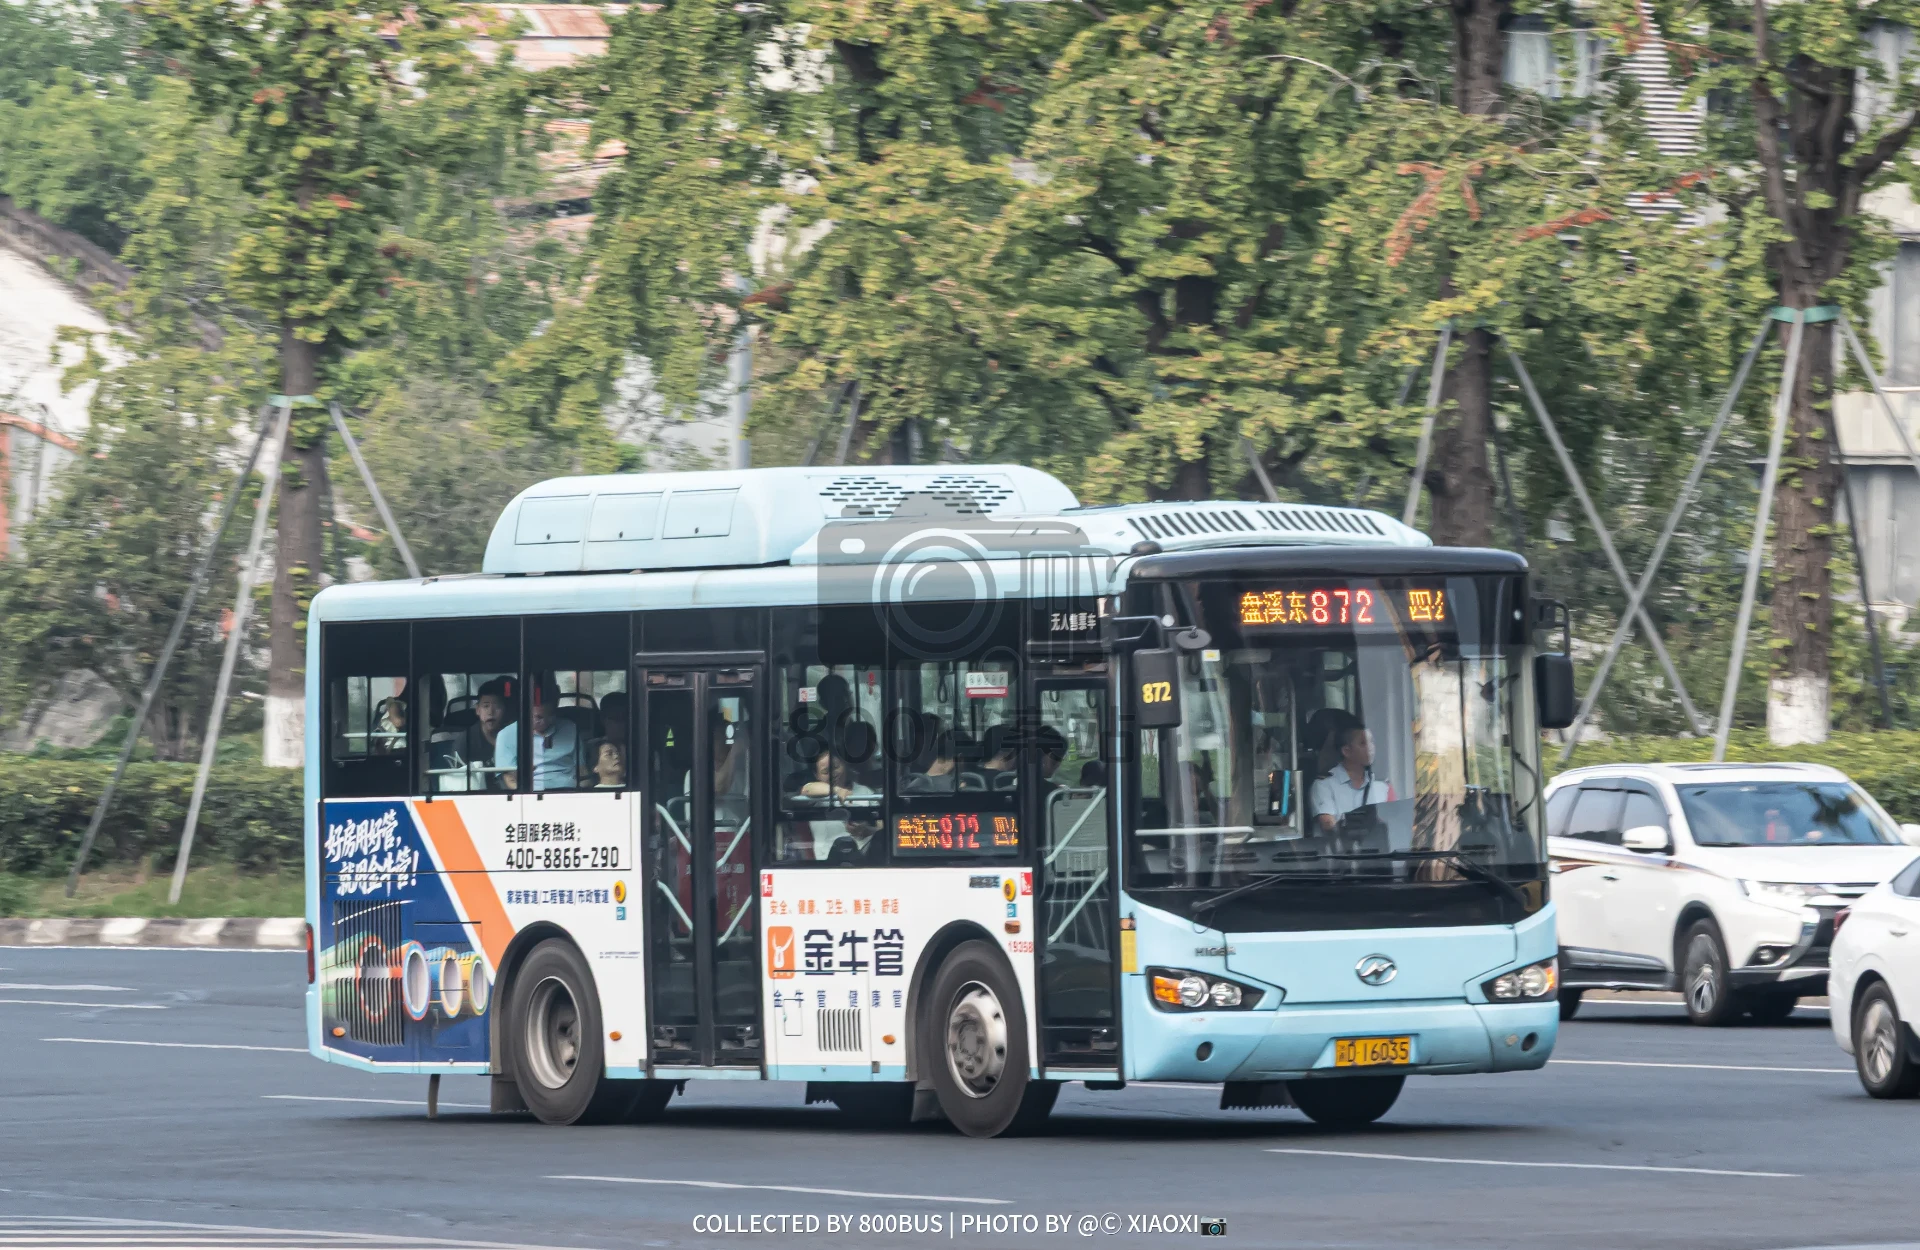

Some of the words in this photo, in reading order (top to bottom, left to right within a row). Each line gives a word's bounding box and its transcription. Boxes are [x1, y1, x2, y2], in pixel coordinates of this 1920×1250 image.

[1241, 591, 1308, 624] 盘溪东
[1311, 590, 1374, 624] 872
[1050, 612, 1097, 631] 无人售票车
[1141, 681, 1172, 704] 872
[506, 846, 619, 869] 400-8866-290
[804, 928, 904, 976] 金牛管
